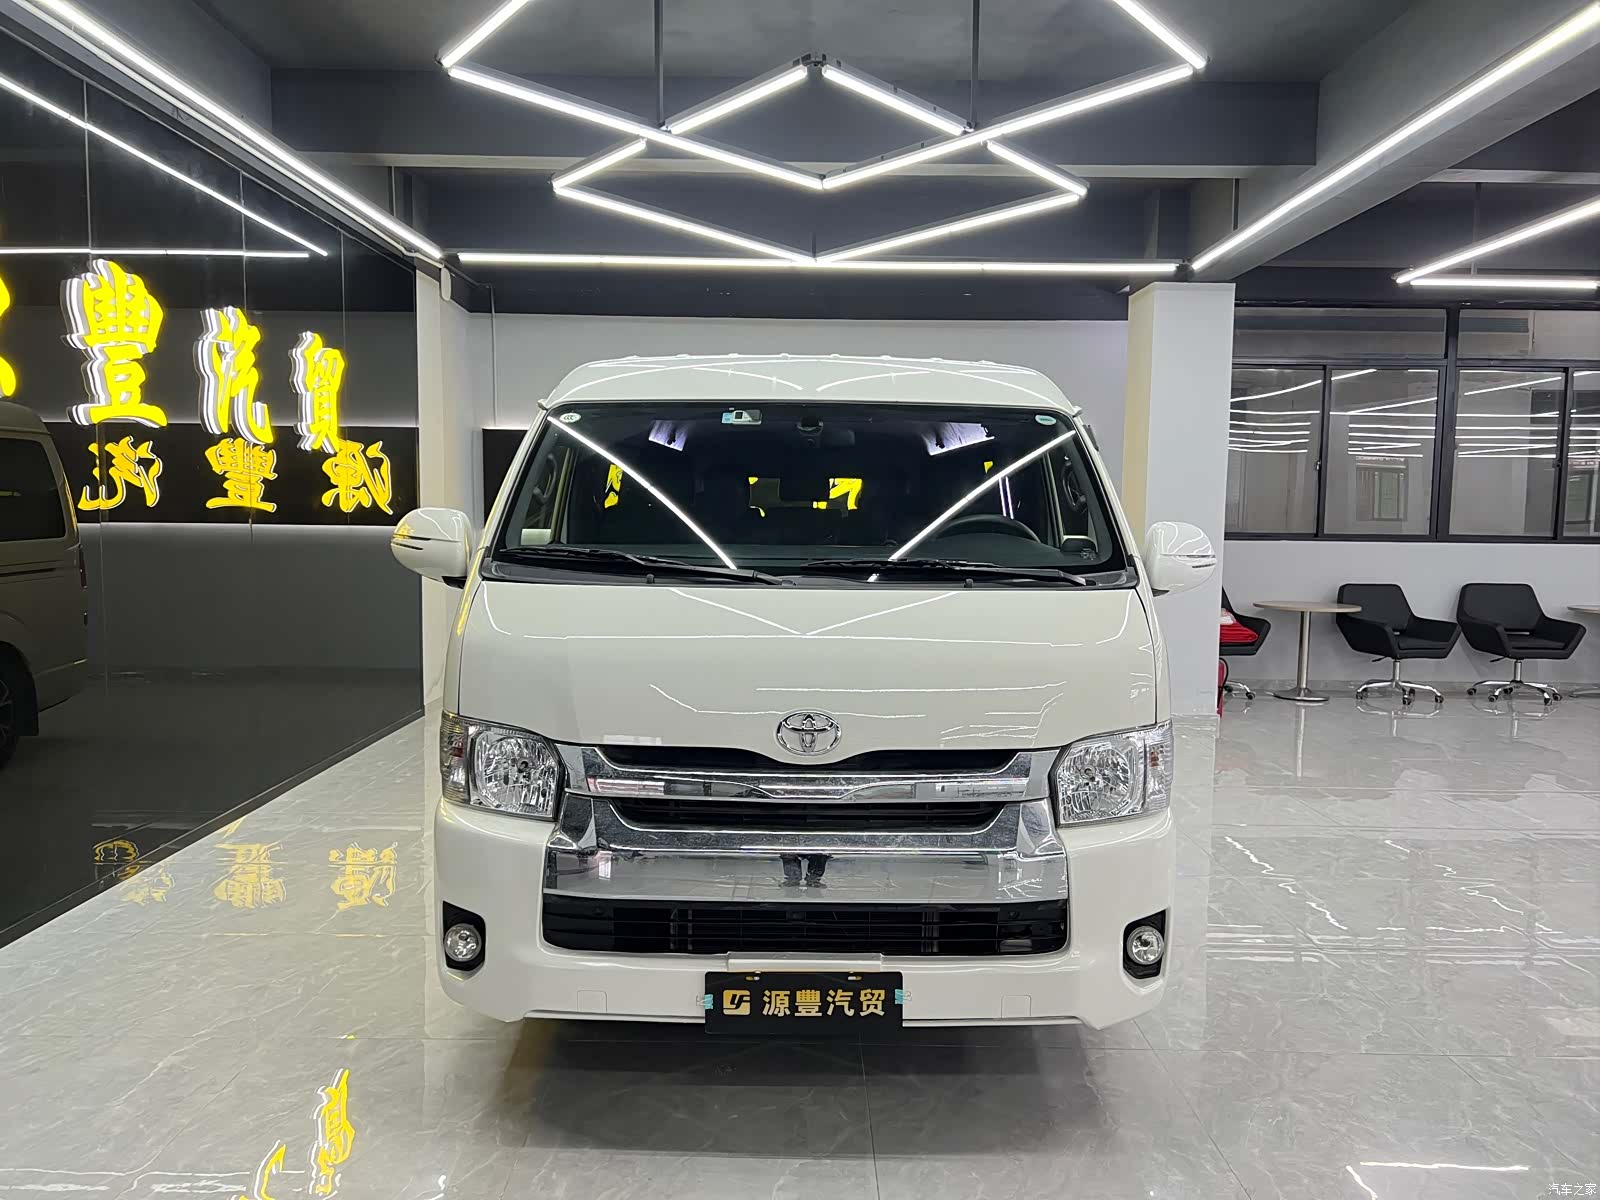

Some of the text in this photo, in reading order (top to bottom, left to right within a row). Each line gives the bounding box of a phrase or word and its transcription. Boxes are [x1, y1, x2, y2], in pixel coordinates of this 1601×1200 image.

[0, 259, 346, 454] 豐汽貿
[762, 988, 886, 1017] 源豐汽贸
